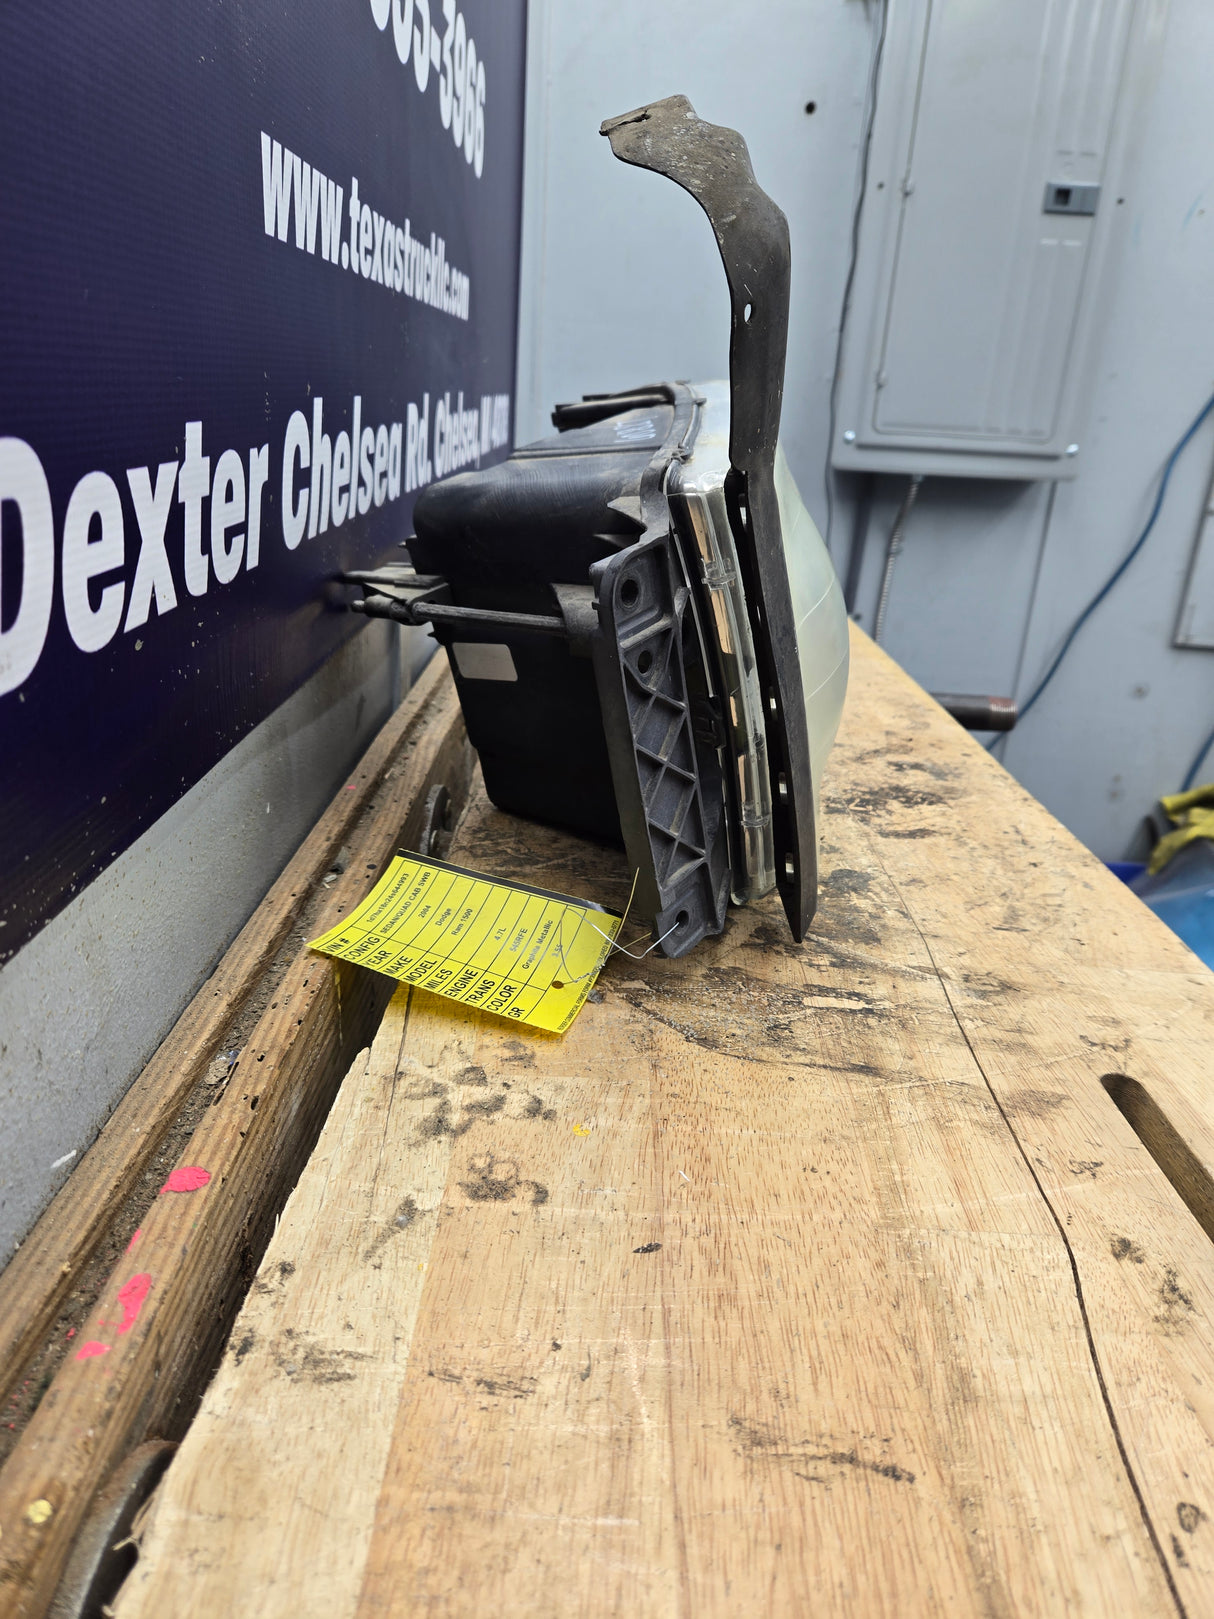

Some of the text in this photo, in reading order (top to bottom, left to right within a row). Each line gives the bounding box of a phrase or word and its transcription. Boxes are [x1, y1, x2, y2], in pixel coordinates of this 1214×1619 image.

[260, 130, 470, 321] www.texastruckllc.com
[0, 421, 269, 698] Dexter
[281, 395, 403, 550] Chelsea
[404, 392, 432, 493] Rd.
[324, 941, 343, 953] VIN
[343, 935, 381, 961] CONFIG
[408, 886, 422, 901] CAB
[419, 871, 431, 887] SWB
[364, 905, 432, 967] YEAR 2004
[384, 908, 452, 974] MAKE Dodge
[404, 908, 473, 983] MODEL Ram 1500
[424, 968, 454, 990] MILES
[444, 927, 507, 998] ENGINE 4.7L
[465, 979, 496, 1004] TRANS
[487, 984, 518, 1012] COLOR
[507, 1006, 526, 1018] GR
